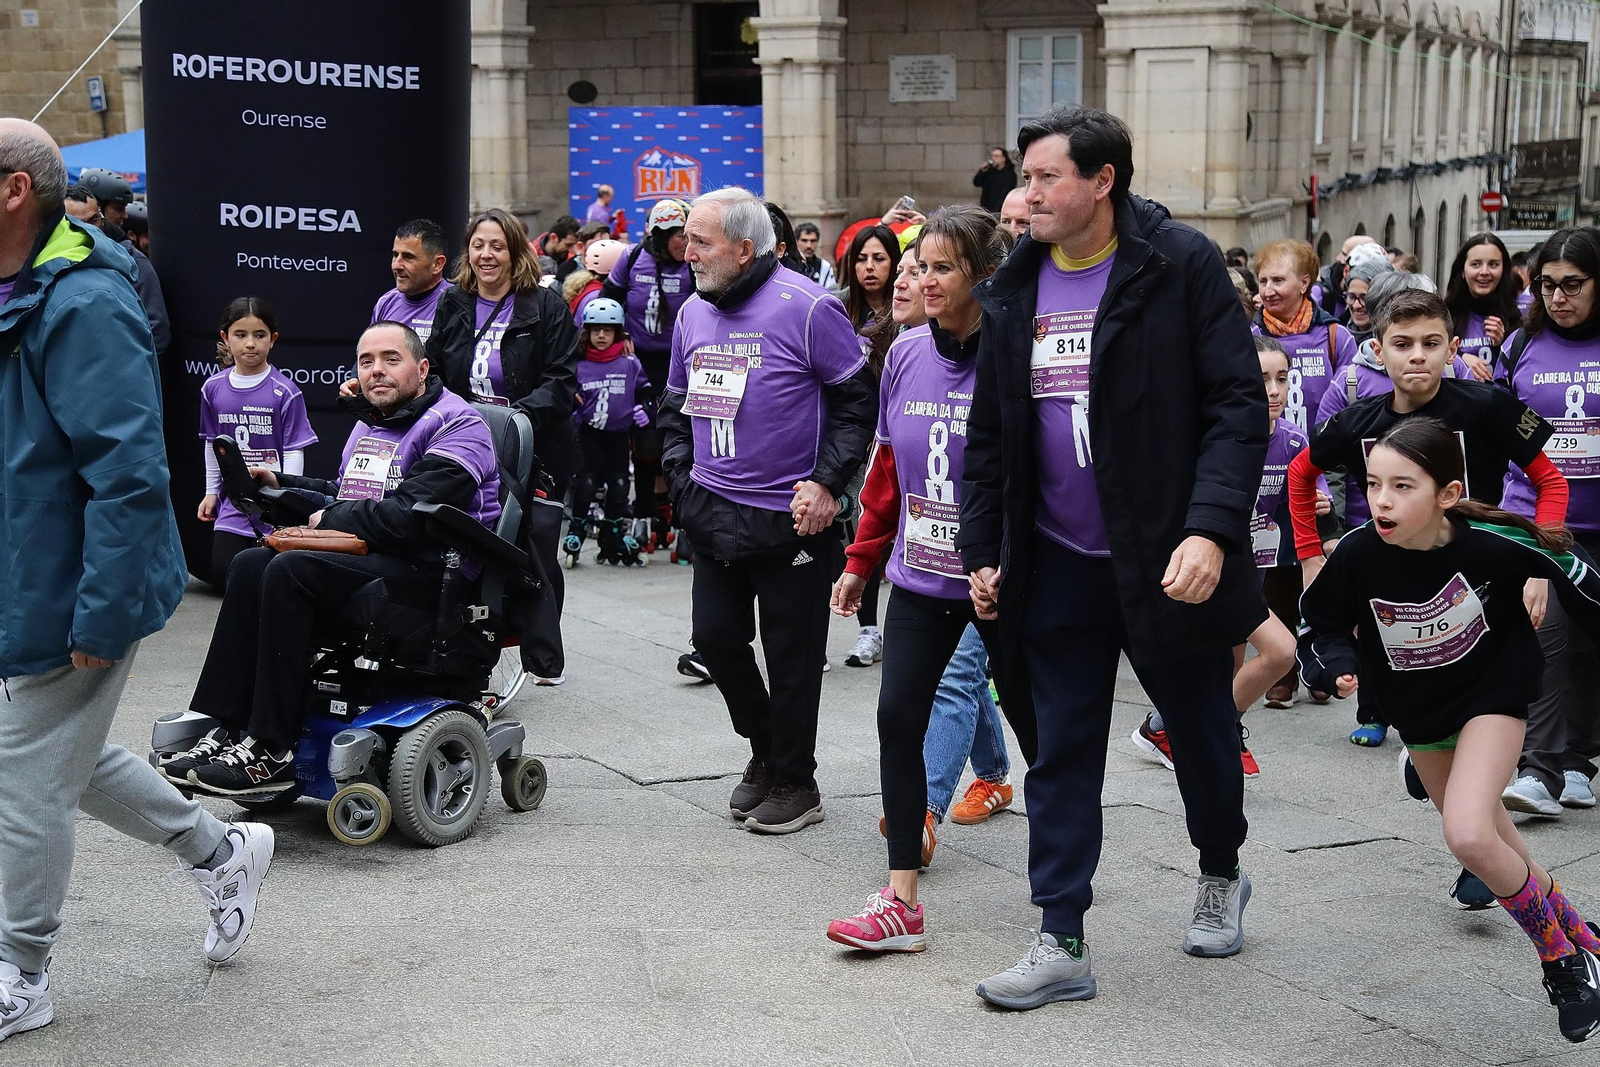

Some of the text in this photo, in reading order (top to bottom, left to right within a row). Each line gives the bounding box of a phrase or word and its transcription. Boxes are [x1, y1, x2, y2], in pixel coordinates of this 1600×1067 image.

[172, 53, 420, 90] ROFEROURENSE
[241, 109, 327, 129] Ourense
[640, 168, 700, 195] RUN
[219, 202, 362, 233] ROIPESA
[236, 252, 348, 272] Pontevedra
[1047, 324, 1068, 332] MULLER
[734, 343, 761, 355] MULLER
[1056, 337, 1086, 354] 814
[472, 340, 492, 379] 8
[1292, 356, 1324, 368] DA MULLER
[1301, 366, 1326, 377] OURENSE
[1532, 371, 1572, 385] CARREIRA
[1574, 371, 1586, 383] DA
[704, 372, 724, 386] 744
[903, 400, 938, 418] CARREIRA
[939, 403, 951, 419] DA
[239, 414, 249, 425] DA
[248, 414, 272, 426] MULLER
[248, 424, 273, 436] OURENSE
[1552, 437, 1578, 449] 739
[354, 457, 370, 470] 747
[923, 509, 941, 518] MULLER
[931, 503, 957, 513] CARREIRA
[930, 524, 958, 541] 815
[791, 556, 814, 566] adidas
[1404, 604, 1434, 614] CARREIRA
[1435, 597, 1445, 605] DA
[1420, 602, 1451, 619] OURENSE
[1411, 618, 1450, 639] 776
